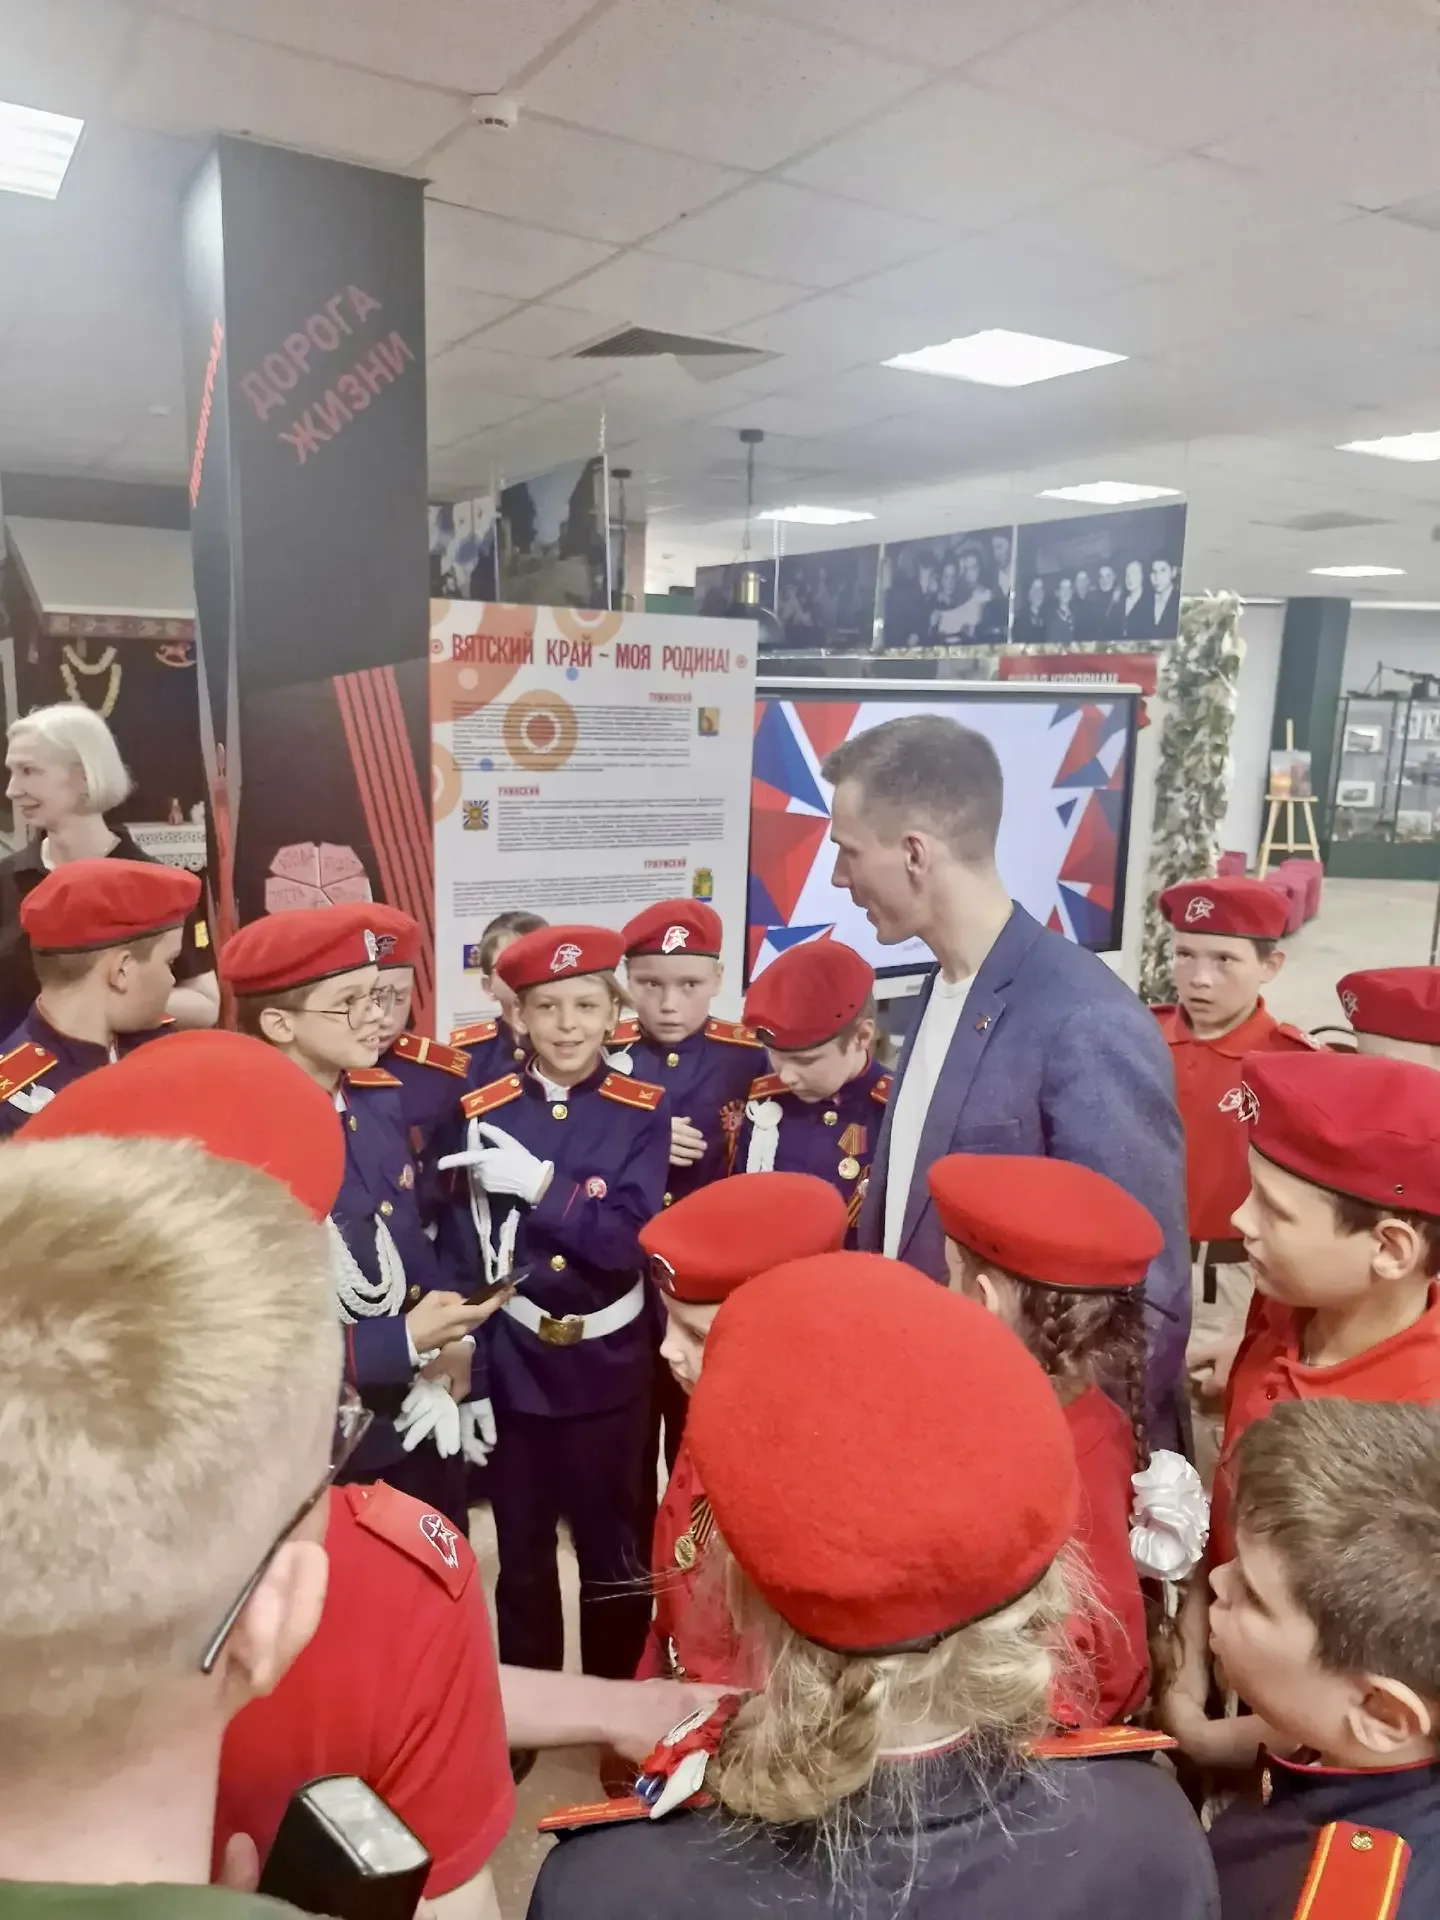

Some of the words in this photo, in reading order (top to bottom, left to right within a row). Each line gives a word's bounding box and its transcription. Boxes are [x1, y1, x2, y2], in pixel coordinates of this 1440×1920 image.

[239, 284, 382, 421] ДОРОГА
[277, 330, 416, 465] ЖИЗНИ
[452, 632, 534, 665] ВЯТСКИЙ
[546, 634, 592, 667] КРАЙ
[616, 643, 651, 670] МОЯ
[662, 645, 730, 678] РОДИНА!
